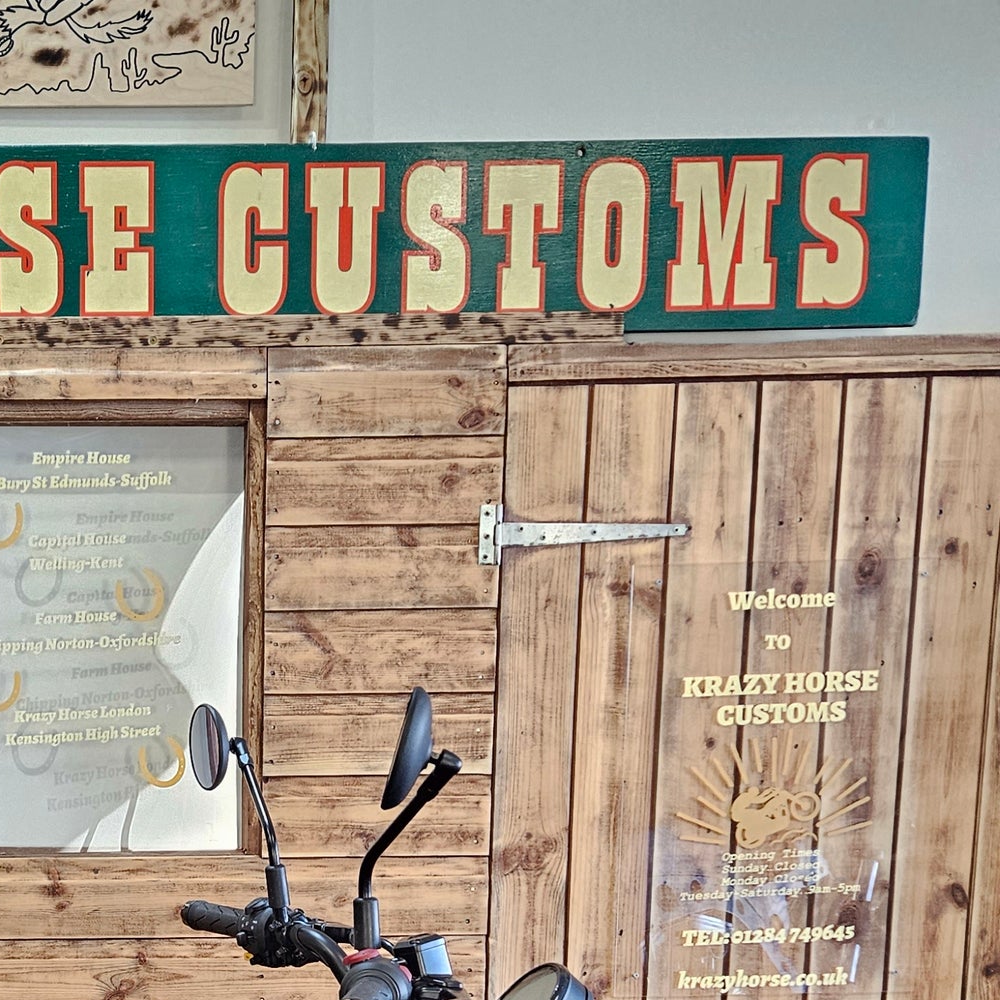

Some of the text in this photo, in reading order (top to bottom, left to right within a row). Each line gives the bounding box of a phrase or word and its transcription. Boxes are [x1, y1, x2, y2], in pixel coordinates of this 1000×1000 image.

[217, 152, 870, 317] CUSTOMS
[32, 451, 131, 468] Empire House
[33, 475, 48, 490] St
[50, 471, 172, 490] Edmunds-Suffolk
[28, 533, 127, 550] Capital House
[29, 556, 124, 573] Welling-Kent
[728, 588, 836, 611] Welcome
[35, 609, 118, 625] Farm House
[764, 634, 792, 651] TO
[682, 669, 880, 698] KRAZY HORSE
[14, 703, 151, 724] Krazy Horse London
[717, 701, 847, 726] CUSTOMS
[5, 725, 161, 747] Kensington High Street
[721, 849, 821, 865] Opening Times
[788, 924, 856, 943] 749645
[677, 966, 848, 994] krazyhorse.co.uk
